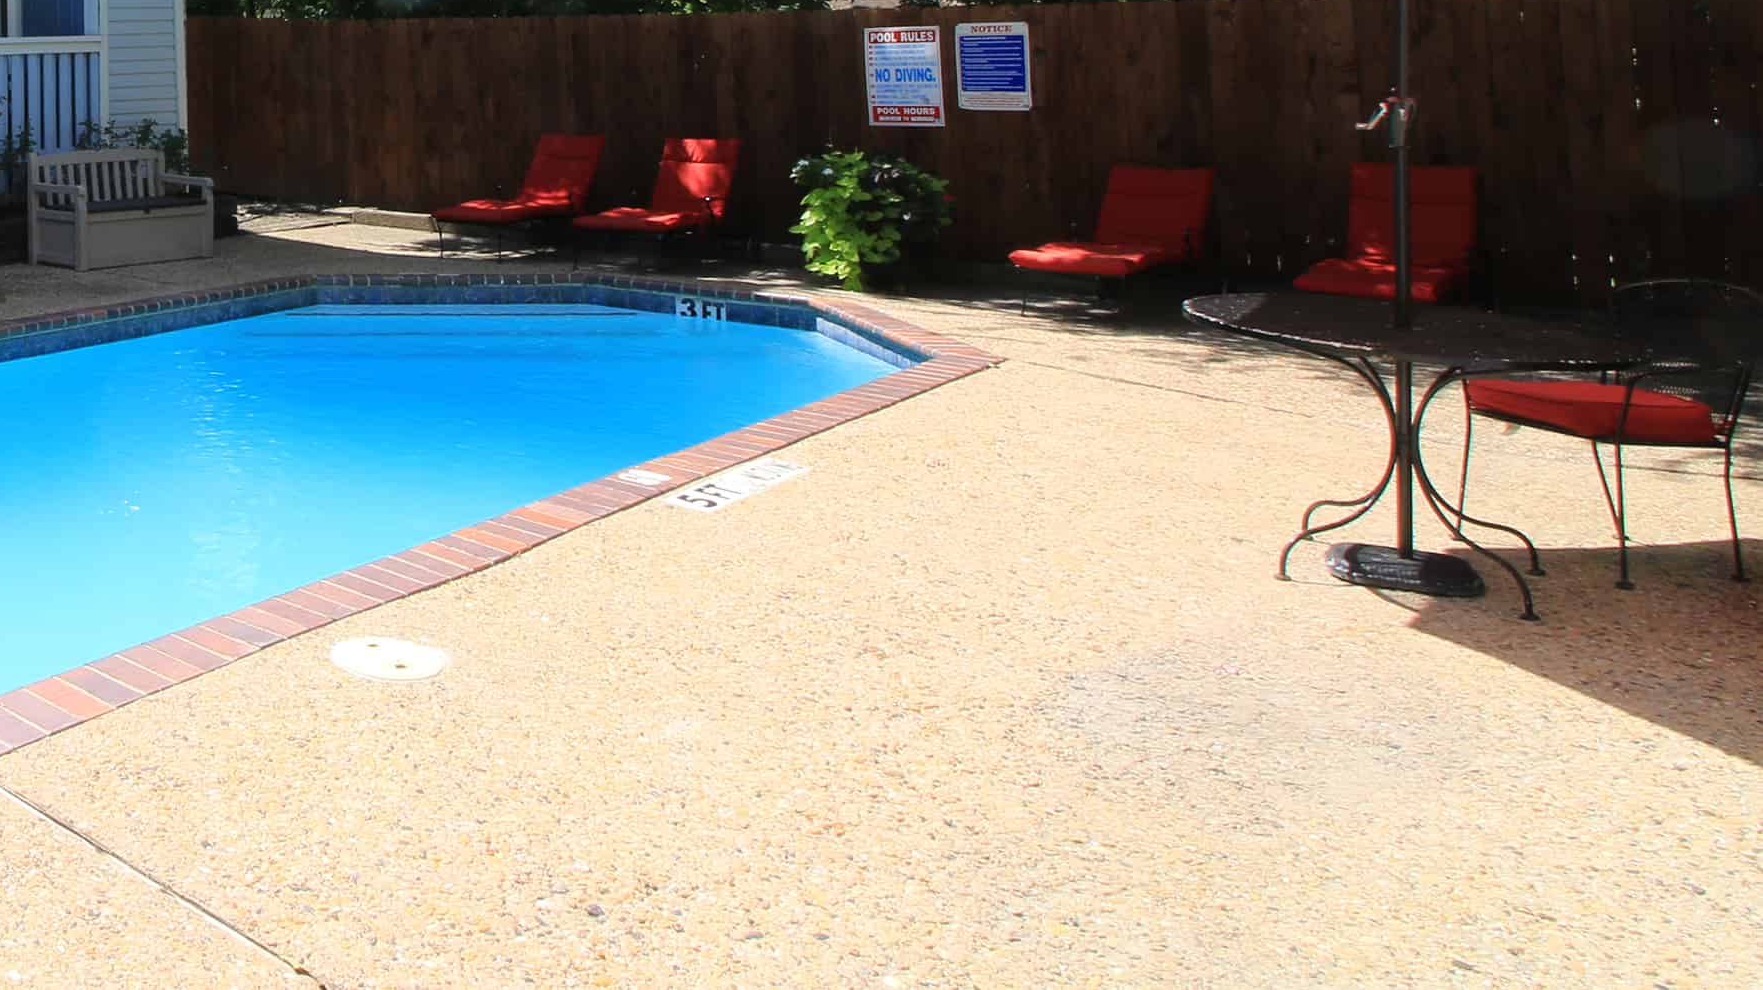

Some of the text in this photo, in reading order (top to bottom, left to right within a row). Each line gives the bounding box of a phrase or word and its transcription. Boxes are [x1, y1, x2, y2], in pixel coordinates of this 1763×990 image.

[971, 25, 1012, 33] NOTICE
[870, 31, 934, 43] POOL RULES
[875, 68, 936, 82] NO DIVING.
[877, 107, 935, 115] POOL HOURS
